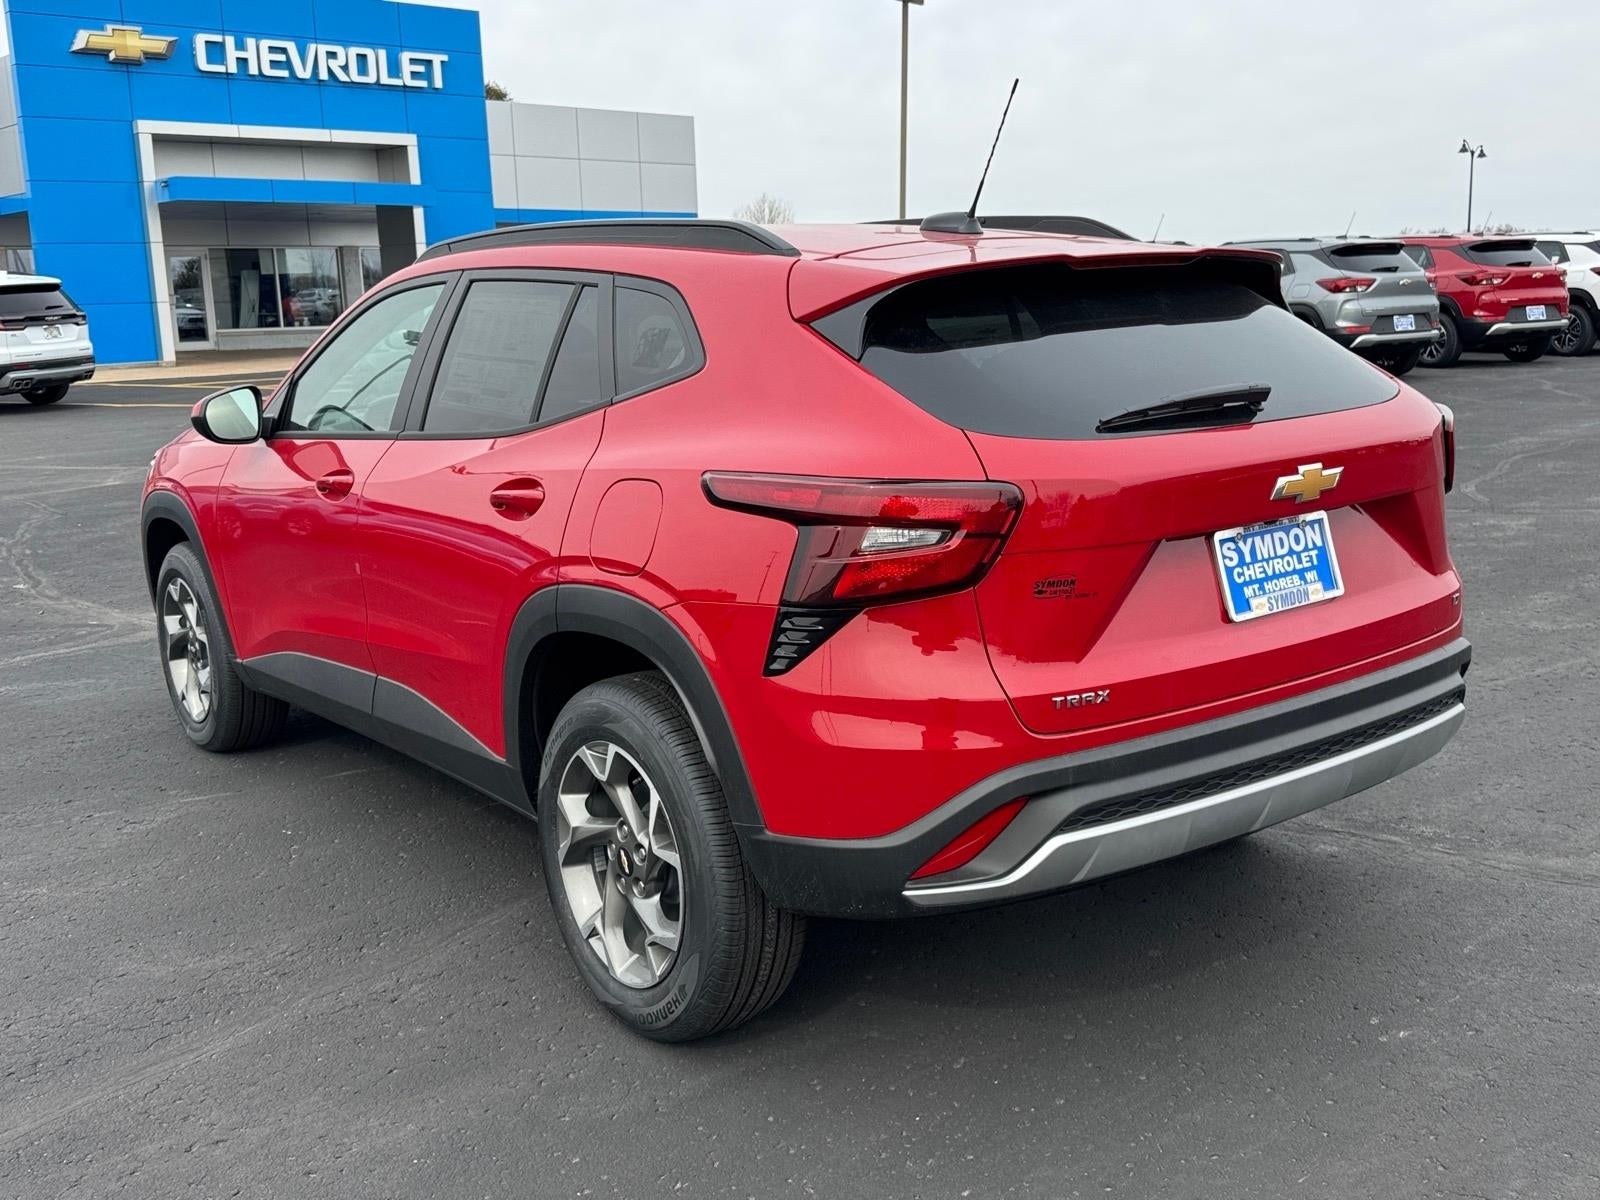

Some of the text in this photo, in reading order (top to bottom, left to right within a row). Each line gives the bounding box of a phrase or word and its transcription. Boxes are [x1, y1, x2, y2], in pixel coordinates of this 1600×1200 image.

[193, 33, 449, 89] CHEVROLET
[1221, 523, 1323, 568] SYMDON
[1233, 549, 1319, 584] CHEVROLET
[1033, 578, 1076, 590] SYMDON
[1243, 570, 1319, 598] MT. HOREB, WI
[1266, 587, 1310, 612] SYMDON
[1051, 689, 1110, 710] TRAX
